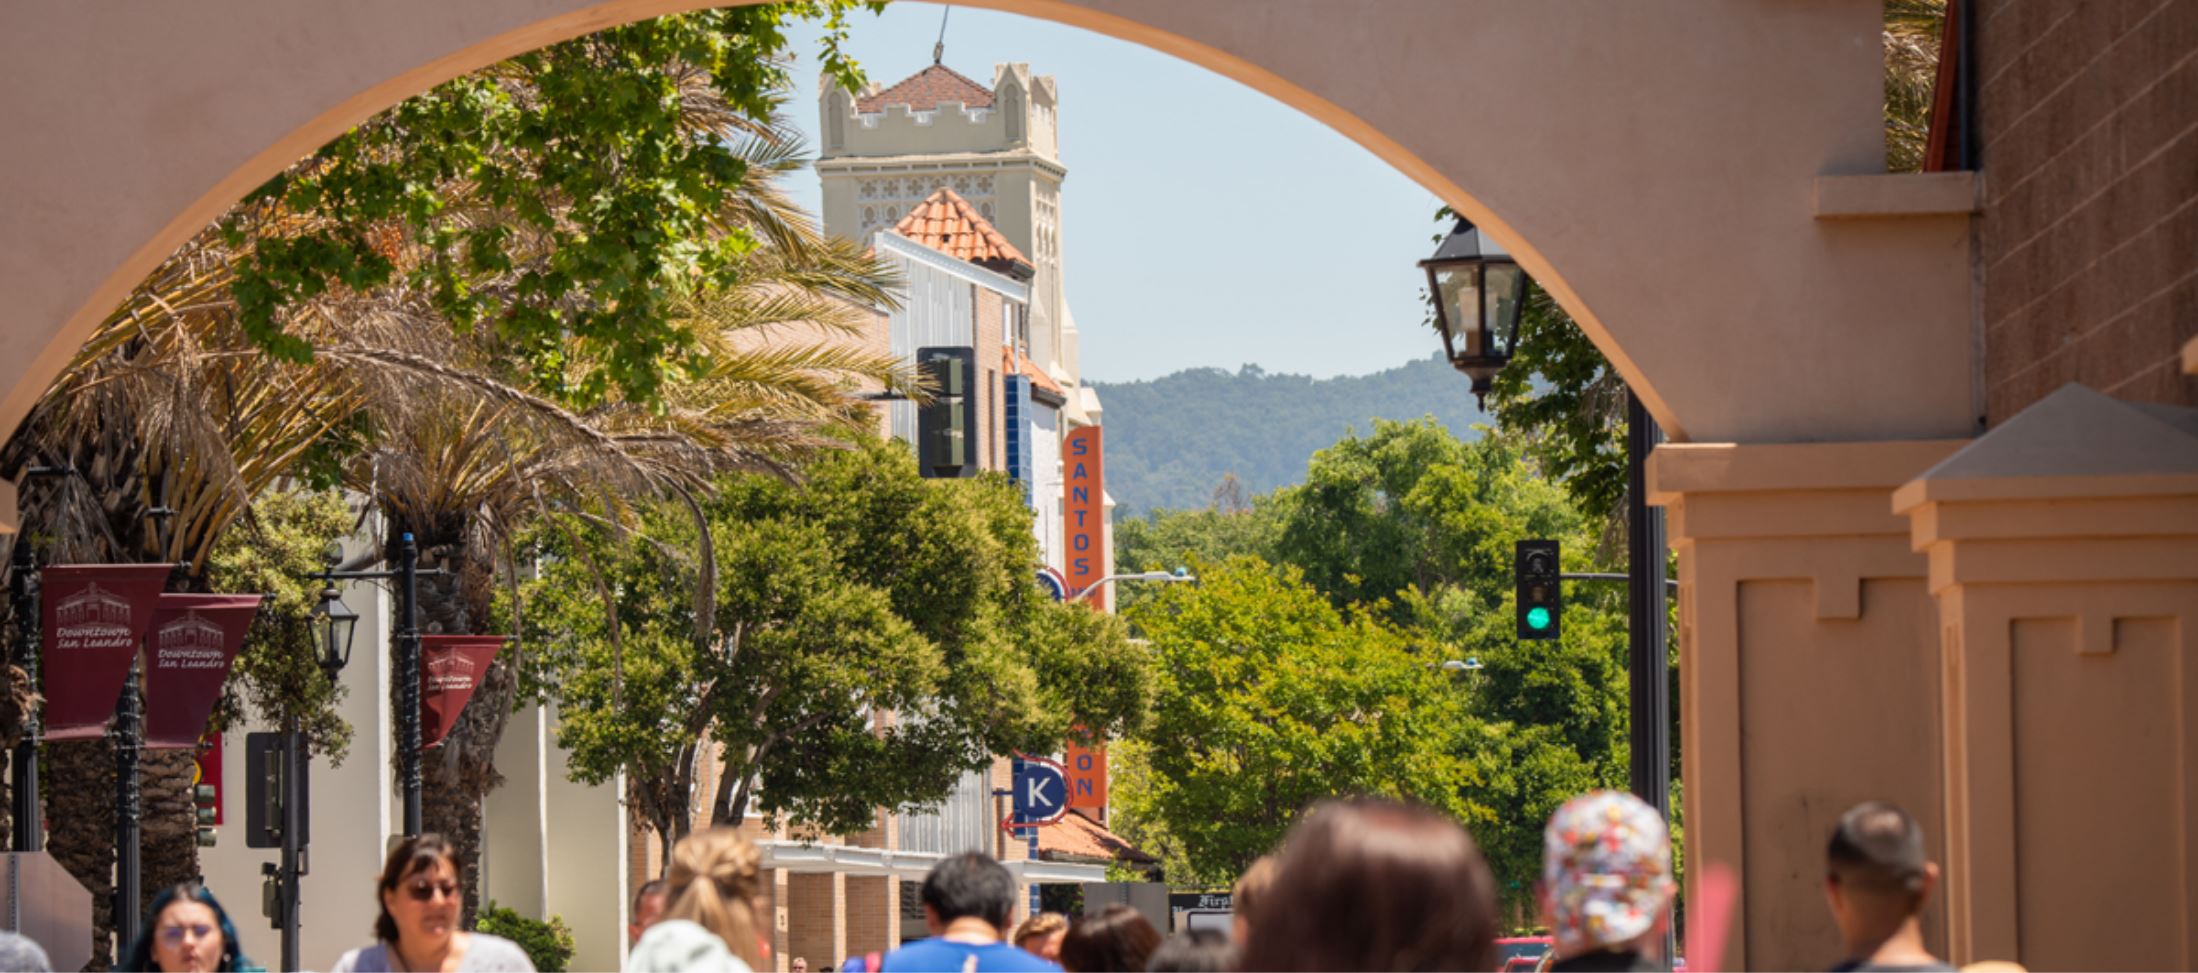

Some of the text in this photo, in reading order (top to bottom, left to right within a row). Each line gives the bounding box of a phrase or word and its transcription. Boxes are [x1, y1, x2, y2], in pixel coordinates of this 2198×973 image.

[1072, 438, 1089, 576] SANTOS
[56, 627, 132, 638] Downtown
[56, 636, 133, 648] San Leandro
[158, 649, 224, 660] Downtown
[158, 656, 225, 669] San Leandro
[1027, 777, 1054, 808] K
